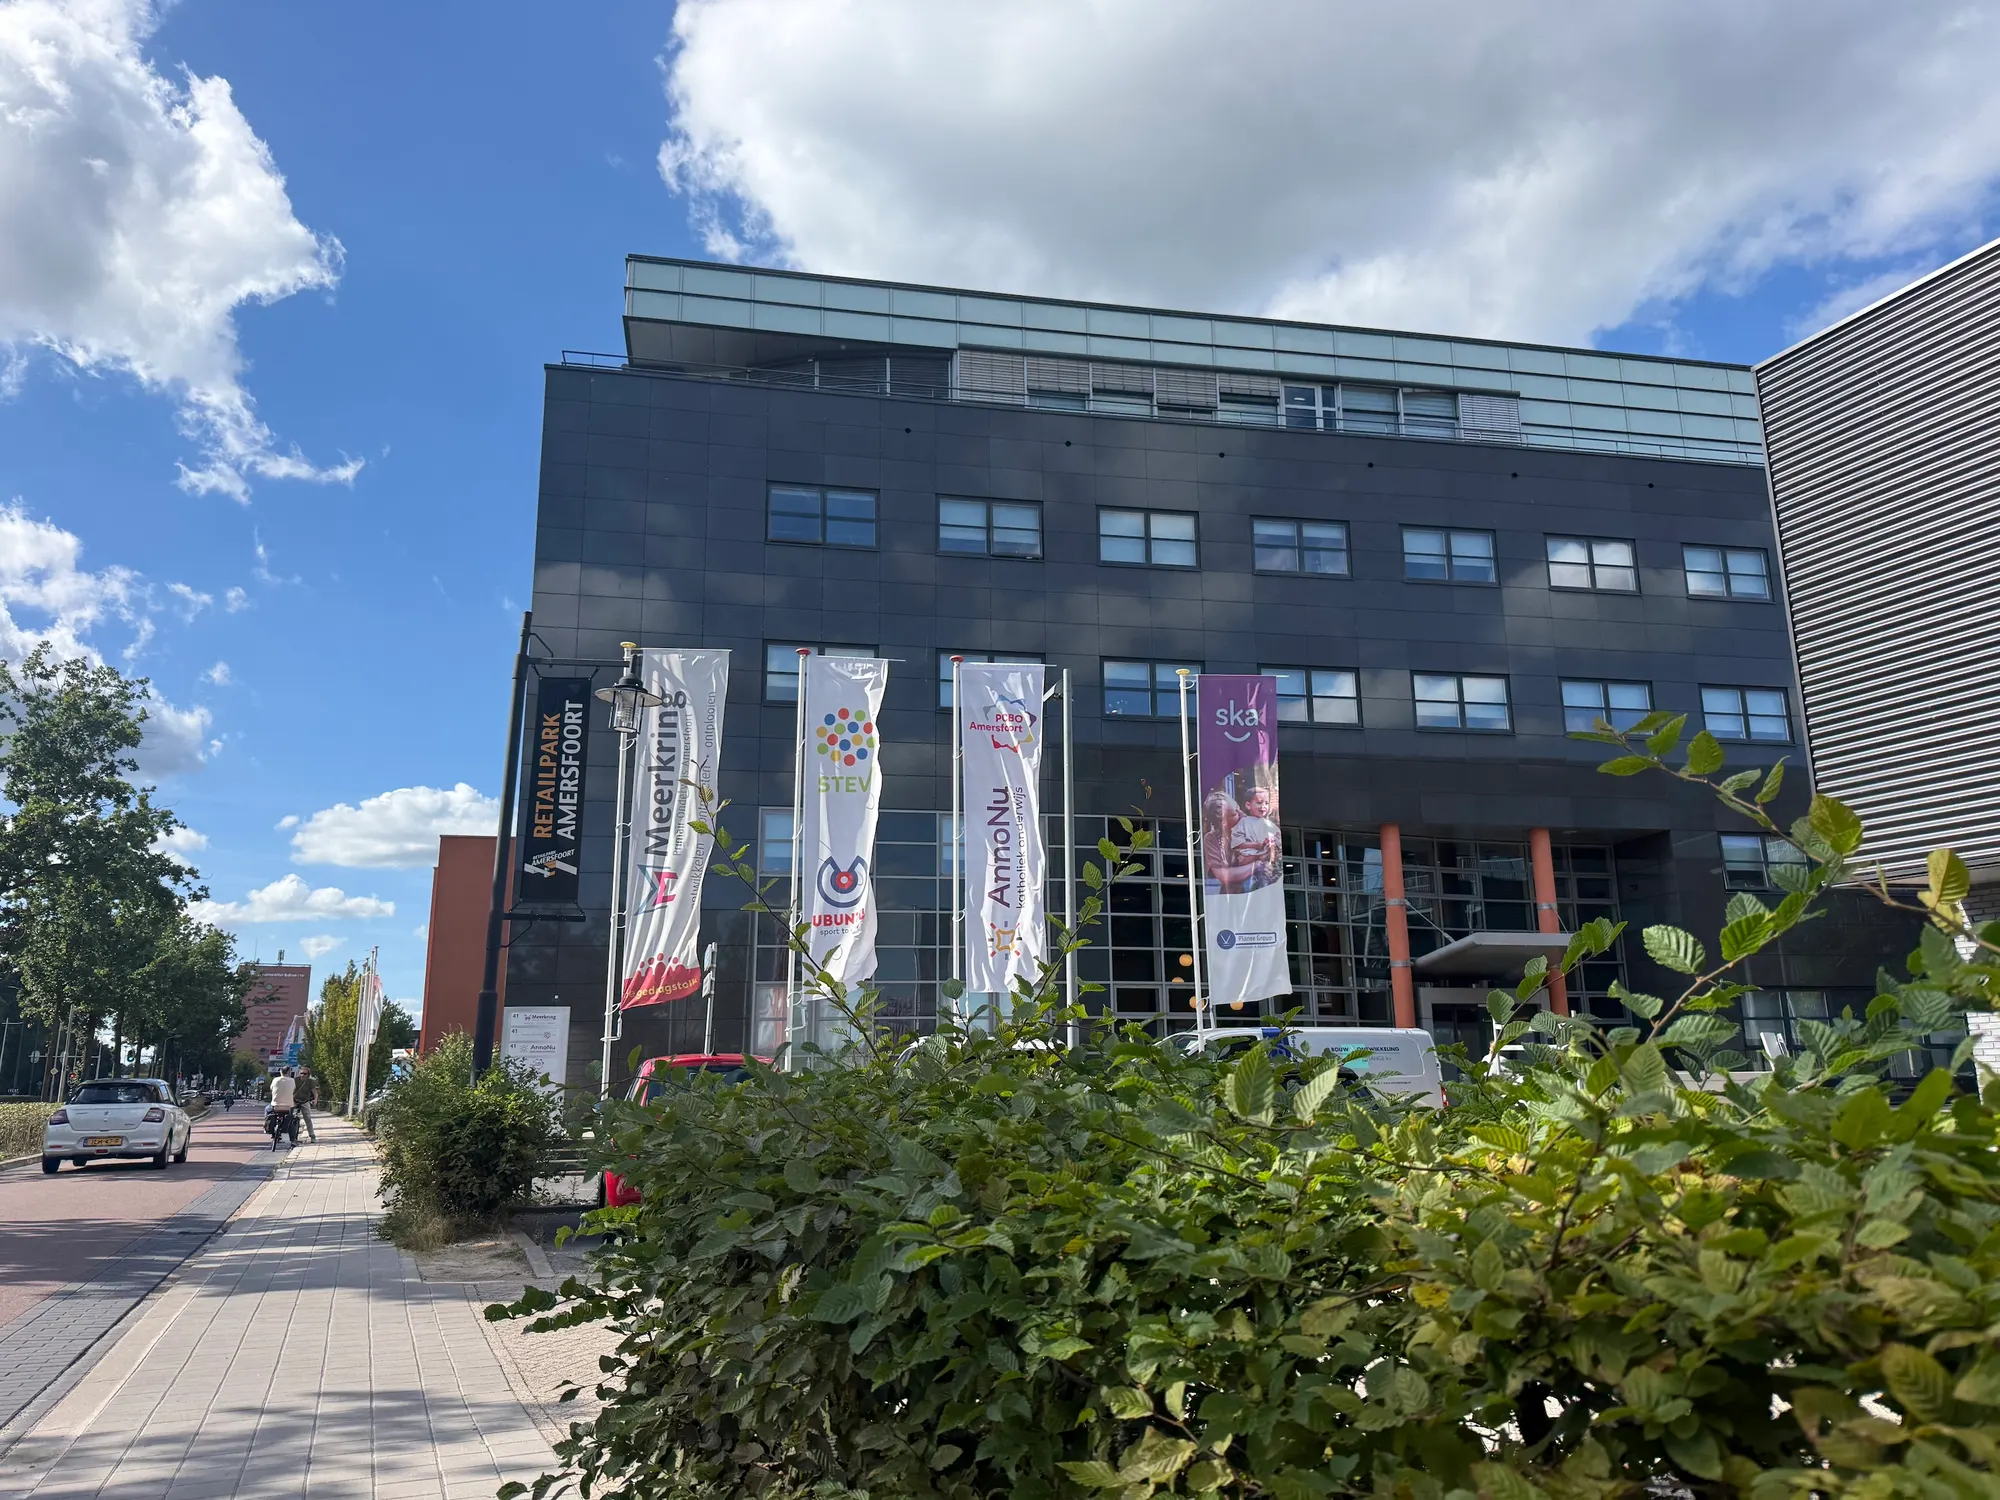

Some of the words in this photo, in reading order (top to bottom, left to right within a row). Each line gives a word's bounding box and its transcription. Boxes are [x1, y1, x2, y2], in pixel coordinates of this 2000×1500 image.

[704, 691, 717, 748] ontplooien
[969, 721, 1023, 733] Amersfoort
[995, 713, 1023, 723] PCBO
[1215, 699, 1259, 727] ska
[533, 712, 561, 839] RETAILPARK
[556, 699, 584, 841] AMERSFOORT
[644, 685, 687, 856] Meerkring
[672, 822, 685, 856] Primair
[681, 713, 693, 767] Amersfoort
[817, 775, 873, 793] STEV
[1013, 786, 1026, 848] onderwijs
[531, 849, 576, 866] AMERSFOORT
[986, 786, 1011, 908] AnnoNu
[1015, 850, 1026, 909] katholiek
[811, 907, 866, 928] UBUNU
[819, 928, 840, 937] sport
